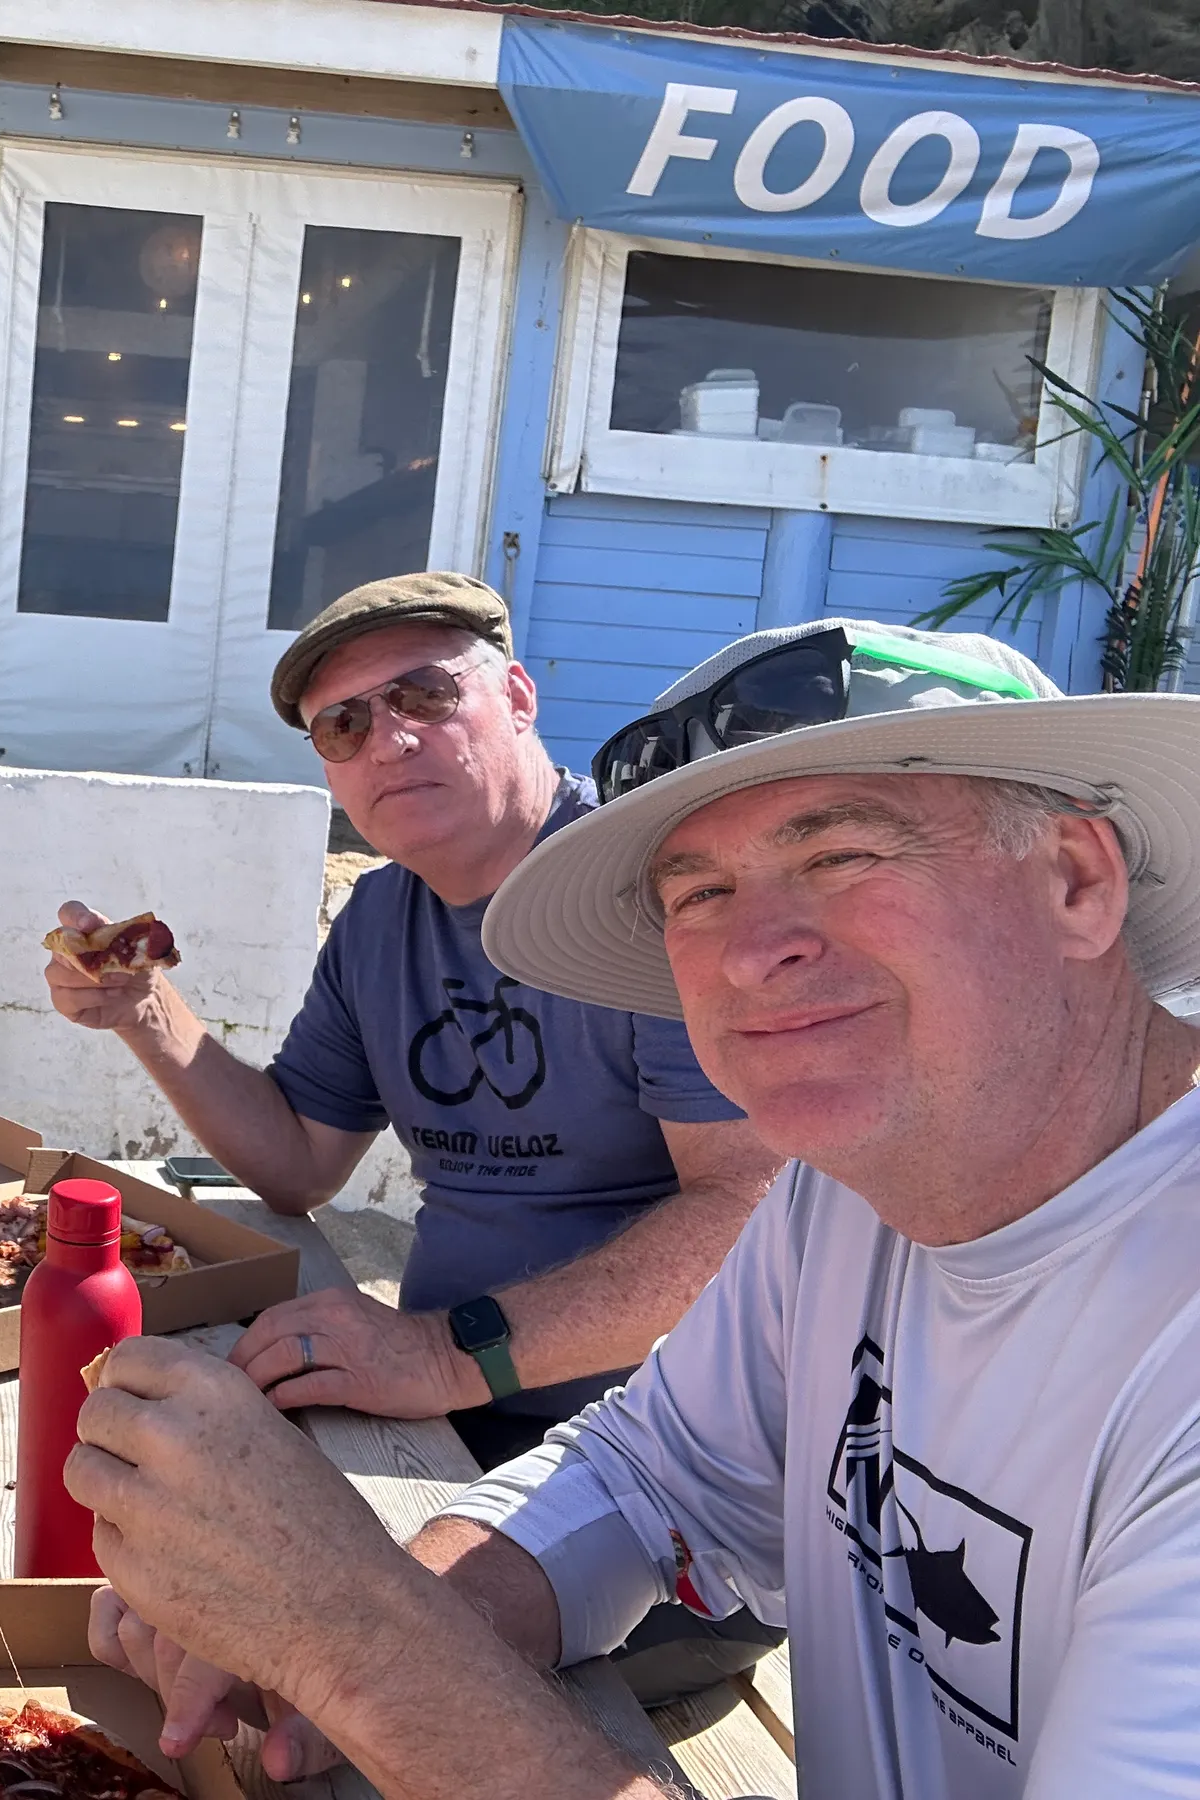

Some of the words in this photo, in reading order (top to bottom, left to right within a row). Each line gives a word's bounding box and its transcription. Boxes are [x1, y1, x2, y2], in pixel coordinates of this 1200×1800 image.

[625, 82, 1101, 240] FOOD
[411, 1126, 479, 1155] TEAM
[488, 1133, 564, 1159] VELOZ
[439, 1158, 474, 1174] ENJOY
[477, 1164, 503, 1177] THE
[504, 1164, 539, 1177] RIDE
[948, 1707, 1017, 1767] APPAREL
